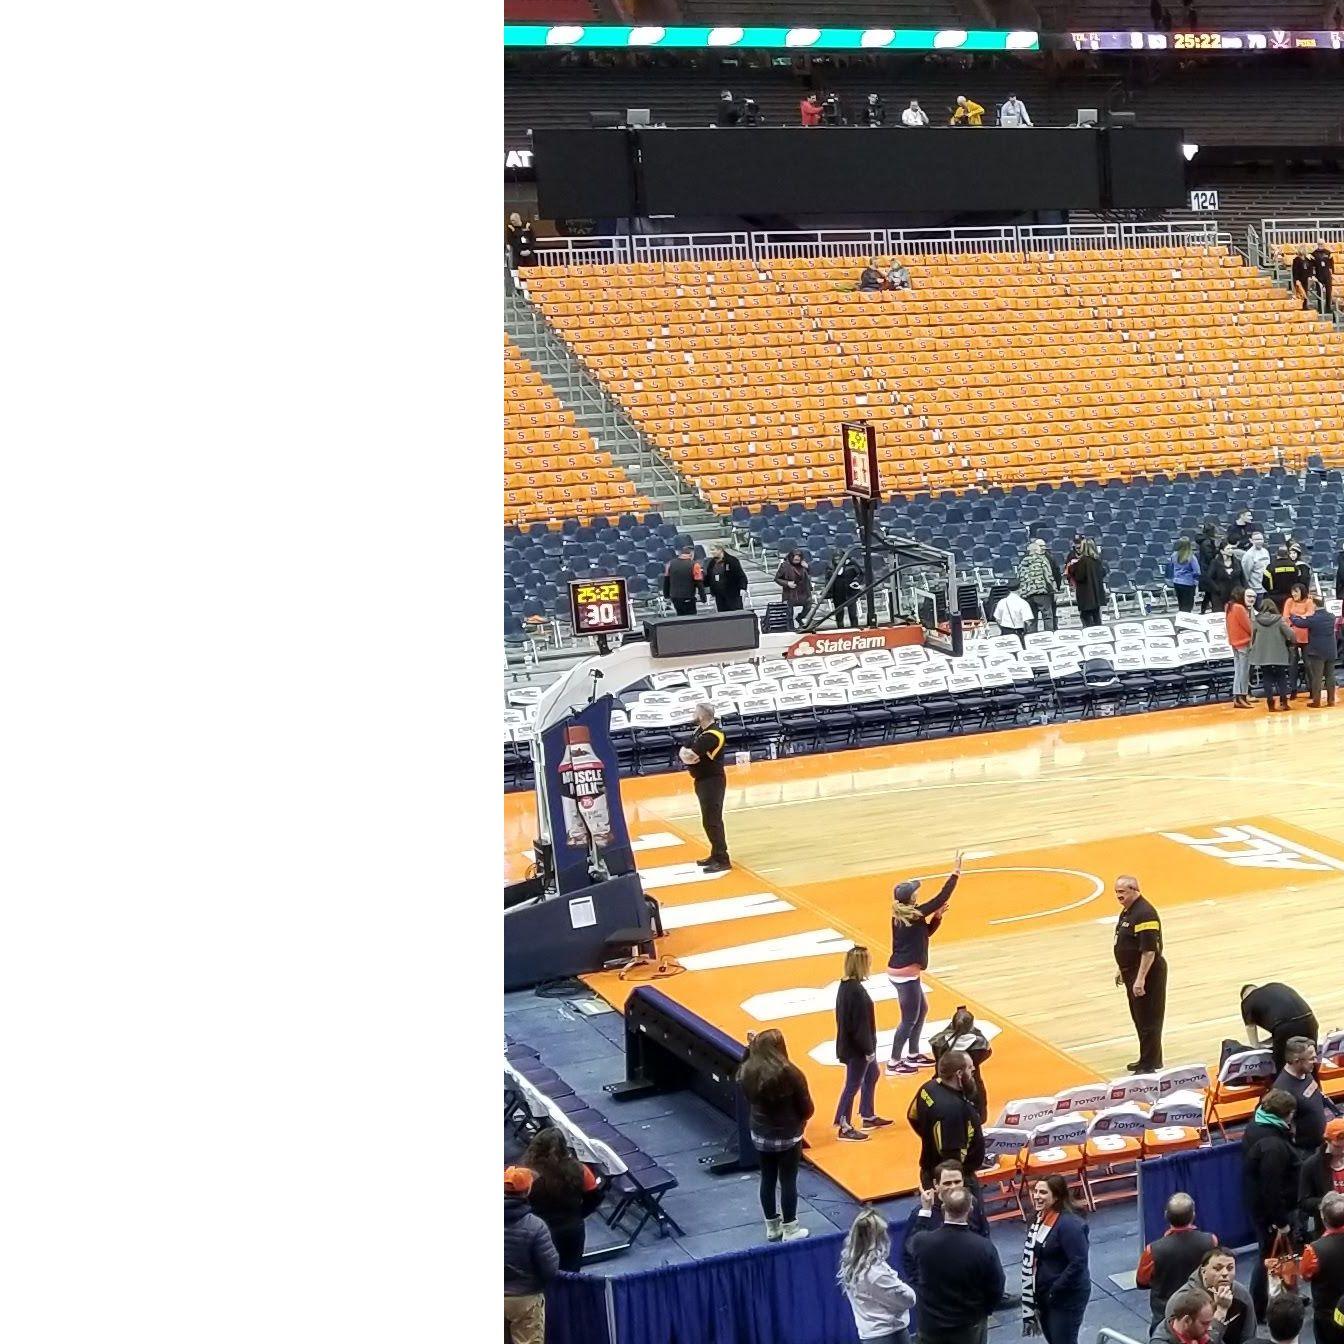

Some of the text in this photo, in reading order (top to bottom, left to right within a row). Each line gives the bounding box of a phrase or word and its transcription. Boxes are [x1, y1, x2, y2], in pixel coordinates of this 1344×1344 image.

[1174, 33, 1222, 49] 25:22
[1193, 192, 1217, 210] 124
[577, 584, 620, 604] 25:22
[562, 769, 603, 785] MUSCLE
[1174, 1074, 1207, 1085] TOYOTA
[1128, 1086, 1158, 1094] TOYOTA
[1074, 1096, 1105, 1106] TOYOTA
[1023, 1109, 1054, 1121] TOYOTA
[1114, 1121, 1145, 1130] TOYOTA
[1053, 1130, 1086, 1142] TOYOTA
